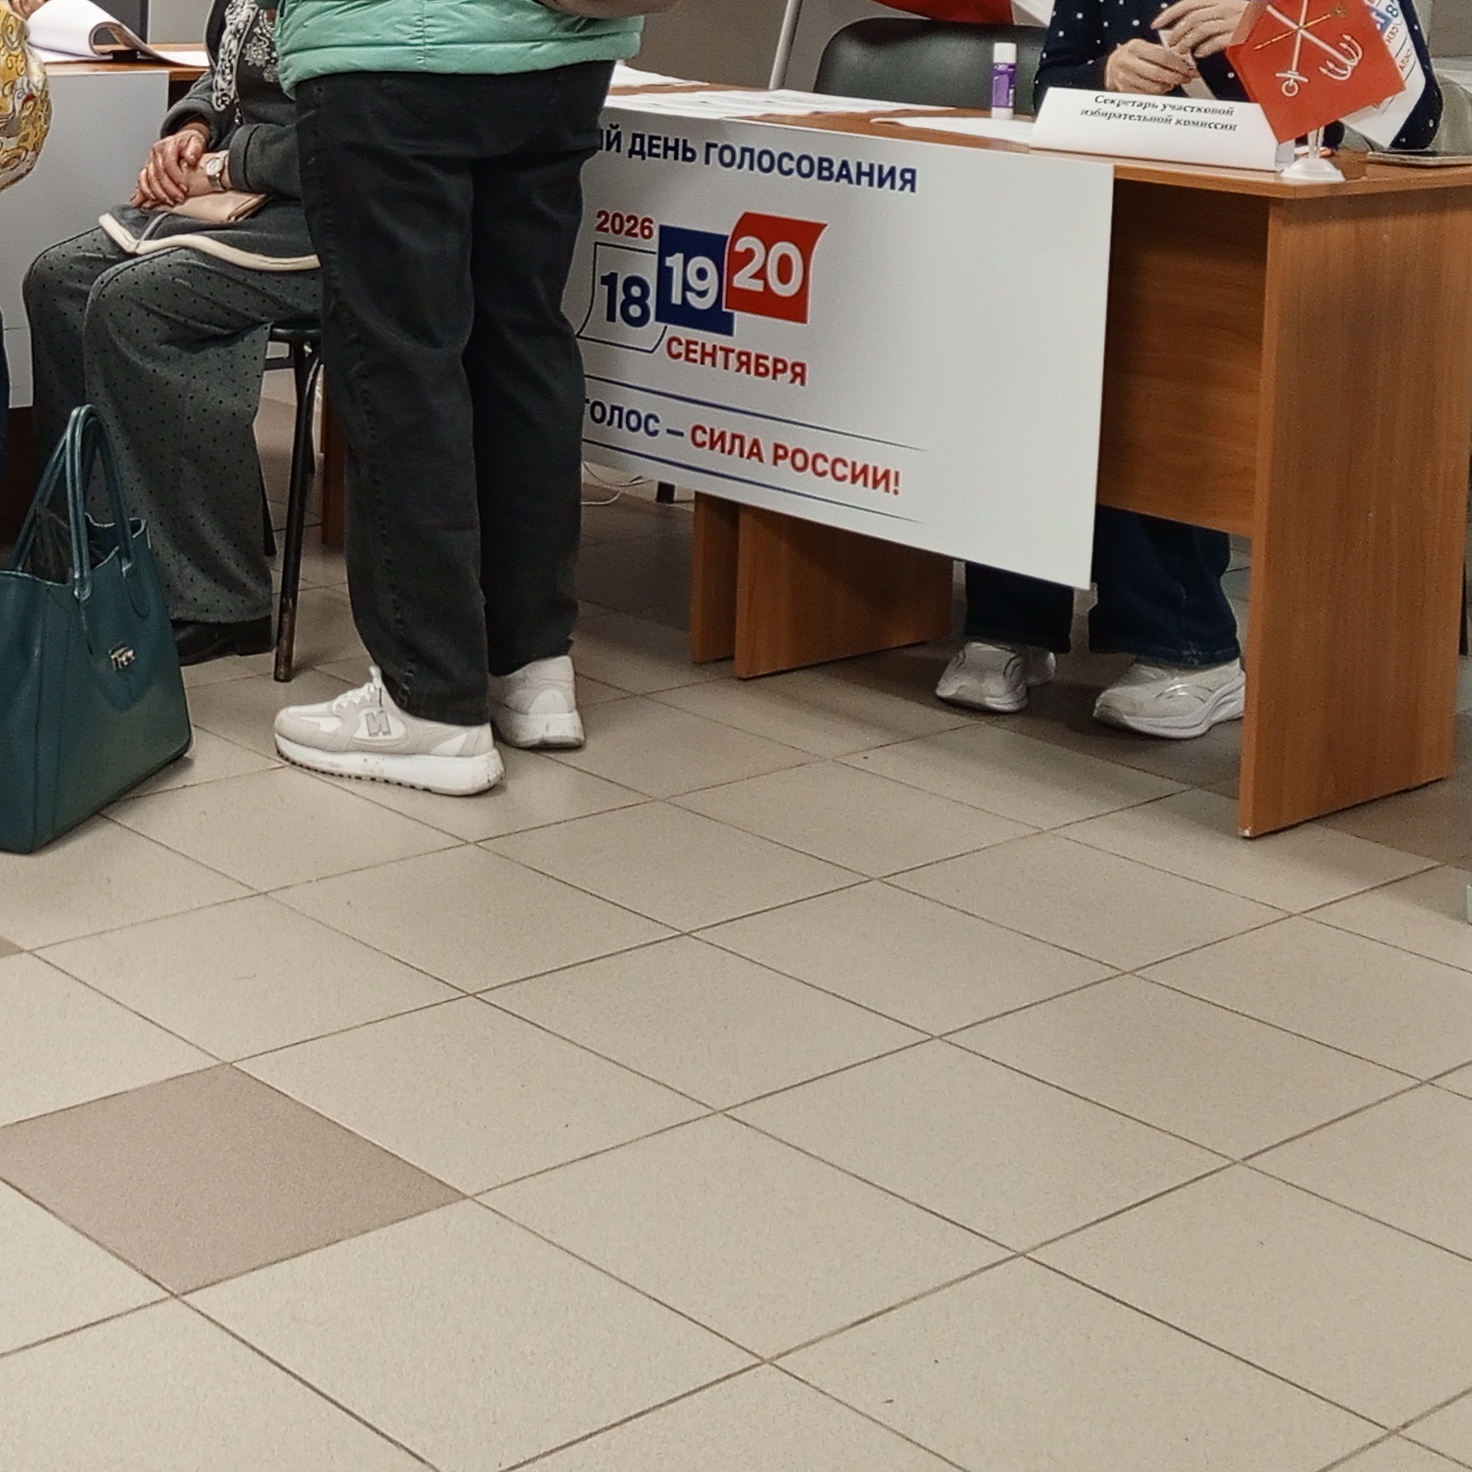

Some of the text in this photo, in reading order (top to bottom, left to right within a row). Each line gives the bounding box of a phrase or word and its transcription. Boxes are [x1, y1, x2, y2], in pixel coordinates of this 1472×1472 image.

[1080, 108, 1238, 132] избирательной комиссии
[1094, 95, 1234, 116] Секретарь участковой
[628, 132, 698, 162] ДЕНЬ
[704, 142, 916, 193] ГОЛОСОВАНИЯ
[596, 210, 654, 240] 2026
[665, 252, 719, 310] 19
[732, 235, 804, 298] 20
[600, 272, 651, 328] 18
[666, 336, 807, 386] СЕНТЯБРЯ
[584, 398, 660, 437] ОЛОС
[690, 424, 764, 463] СИЛА
[772, 443, 900, 495] РОССИИ!
